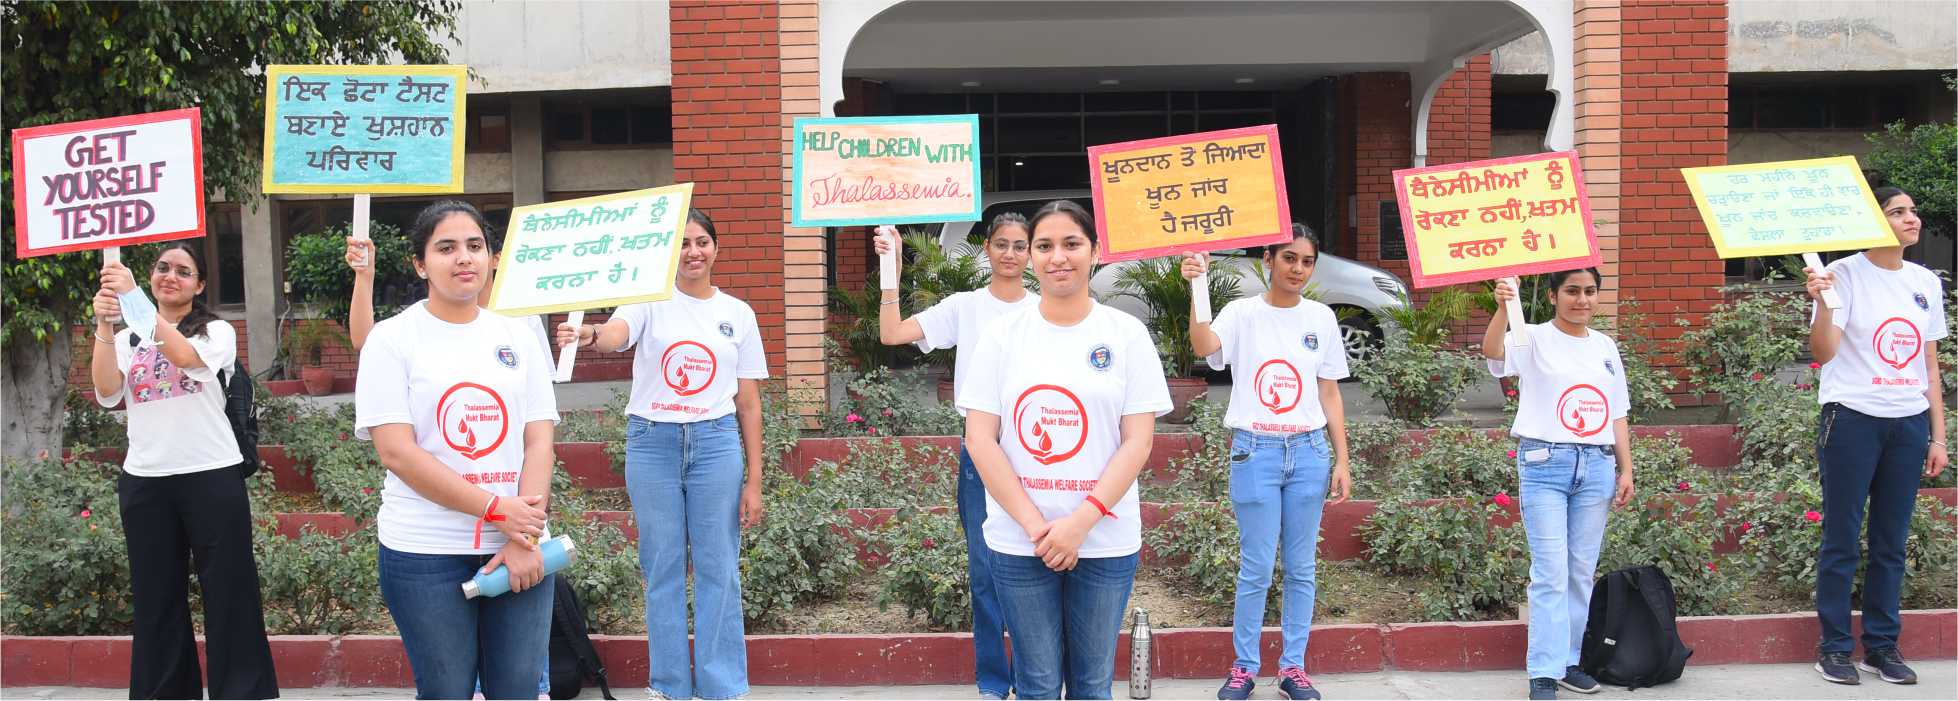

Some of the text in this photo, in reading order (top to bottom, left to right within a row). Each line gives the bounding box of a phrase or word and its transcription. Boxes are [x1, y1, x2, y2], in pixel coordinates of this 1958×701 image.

[342, 75, 389, 103] ਛੋਟਾ
[395, 75, 450, 103] ਟੈਸਟ
[283, 110, 350, 137] ਬਣਾਏ
[64, 129, 137, 168] GET
[305, 144, 398, 172] ਪਰਿਵਾਰ
[802, 131, 974, 164] HELP CHILDREN WITH
[1102, 153, 1173, 184] ਖੂਨਦਾਨ
[1202, 142, 1266, 165] ਜਿਆਦਾ
[42, 161, 167, 206] YOURSELF
[1144, 177, 1229, 210] ਖੂਨ ਜਾਂਚ
[52, 199, 156, 240] TESTED
[1159, 211, 1178, 234] ਹੈ
[1414, 209, 1470, 232] ਰੋਕਣਾ
[514, 243, 567, 265] ਰੋਕਣਾ
[1447, 236, 1508, 260] ਕਰਨਾ
[535, 269, 599, 291] ਕਰਨਾ
[479, 412, 501, 422] Bharat
[1040, 416, 1080, 428] Mukt Bharat
[1041, 406, 1080, 417] Thalassemia
[501, 471, 518, 484] SOCIET
[1054, 478, 1079, 492] WELFARE
